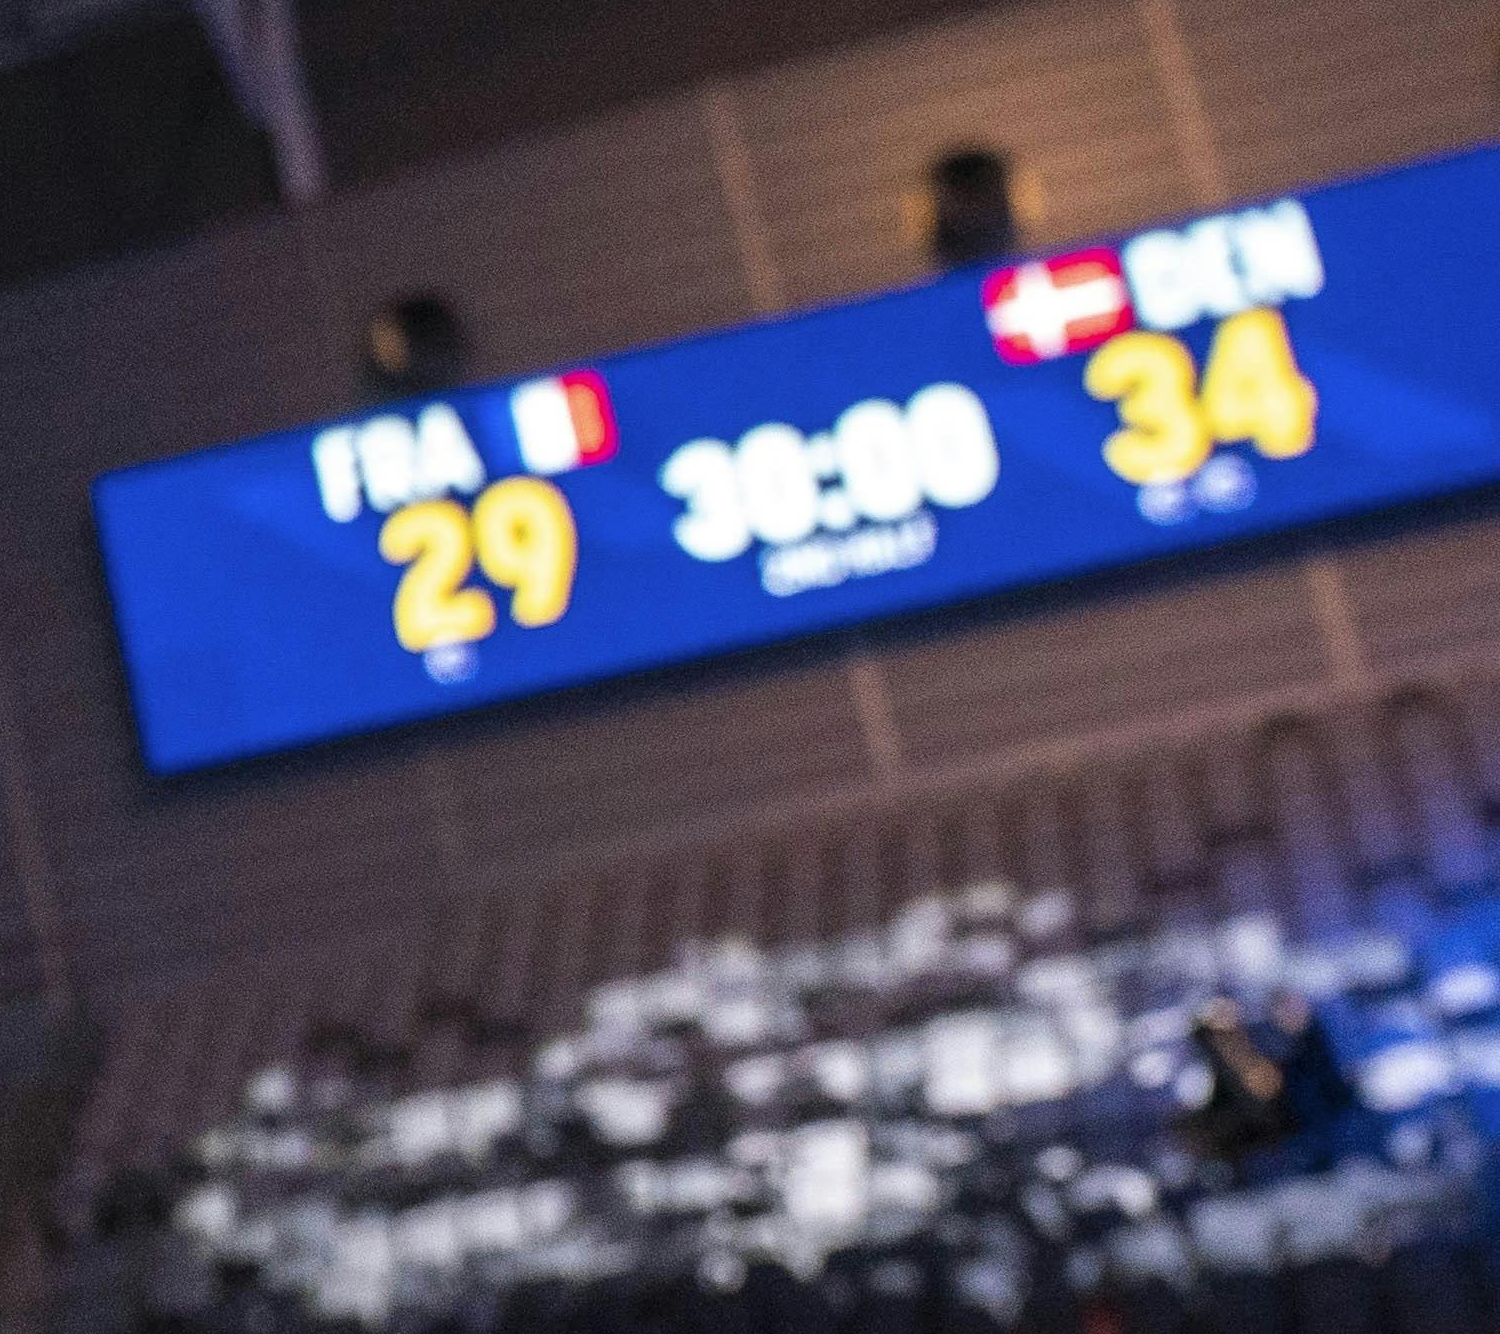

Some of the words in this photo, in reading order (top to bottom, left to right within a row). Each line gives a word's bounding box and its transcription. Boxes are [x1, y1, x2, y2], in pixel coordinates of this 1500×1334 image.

[311, 403, 488, 523] FRA
[657, 380, 1000, 563] 30:00
[1083, 305, 1319, 487] 34
[377, 475, 579, 653] 29
